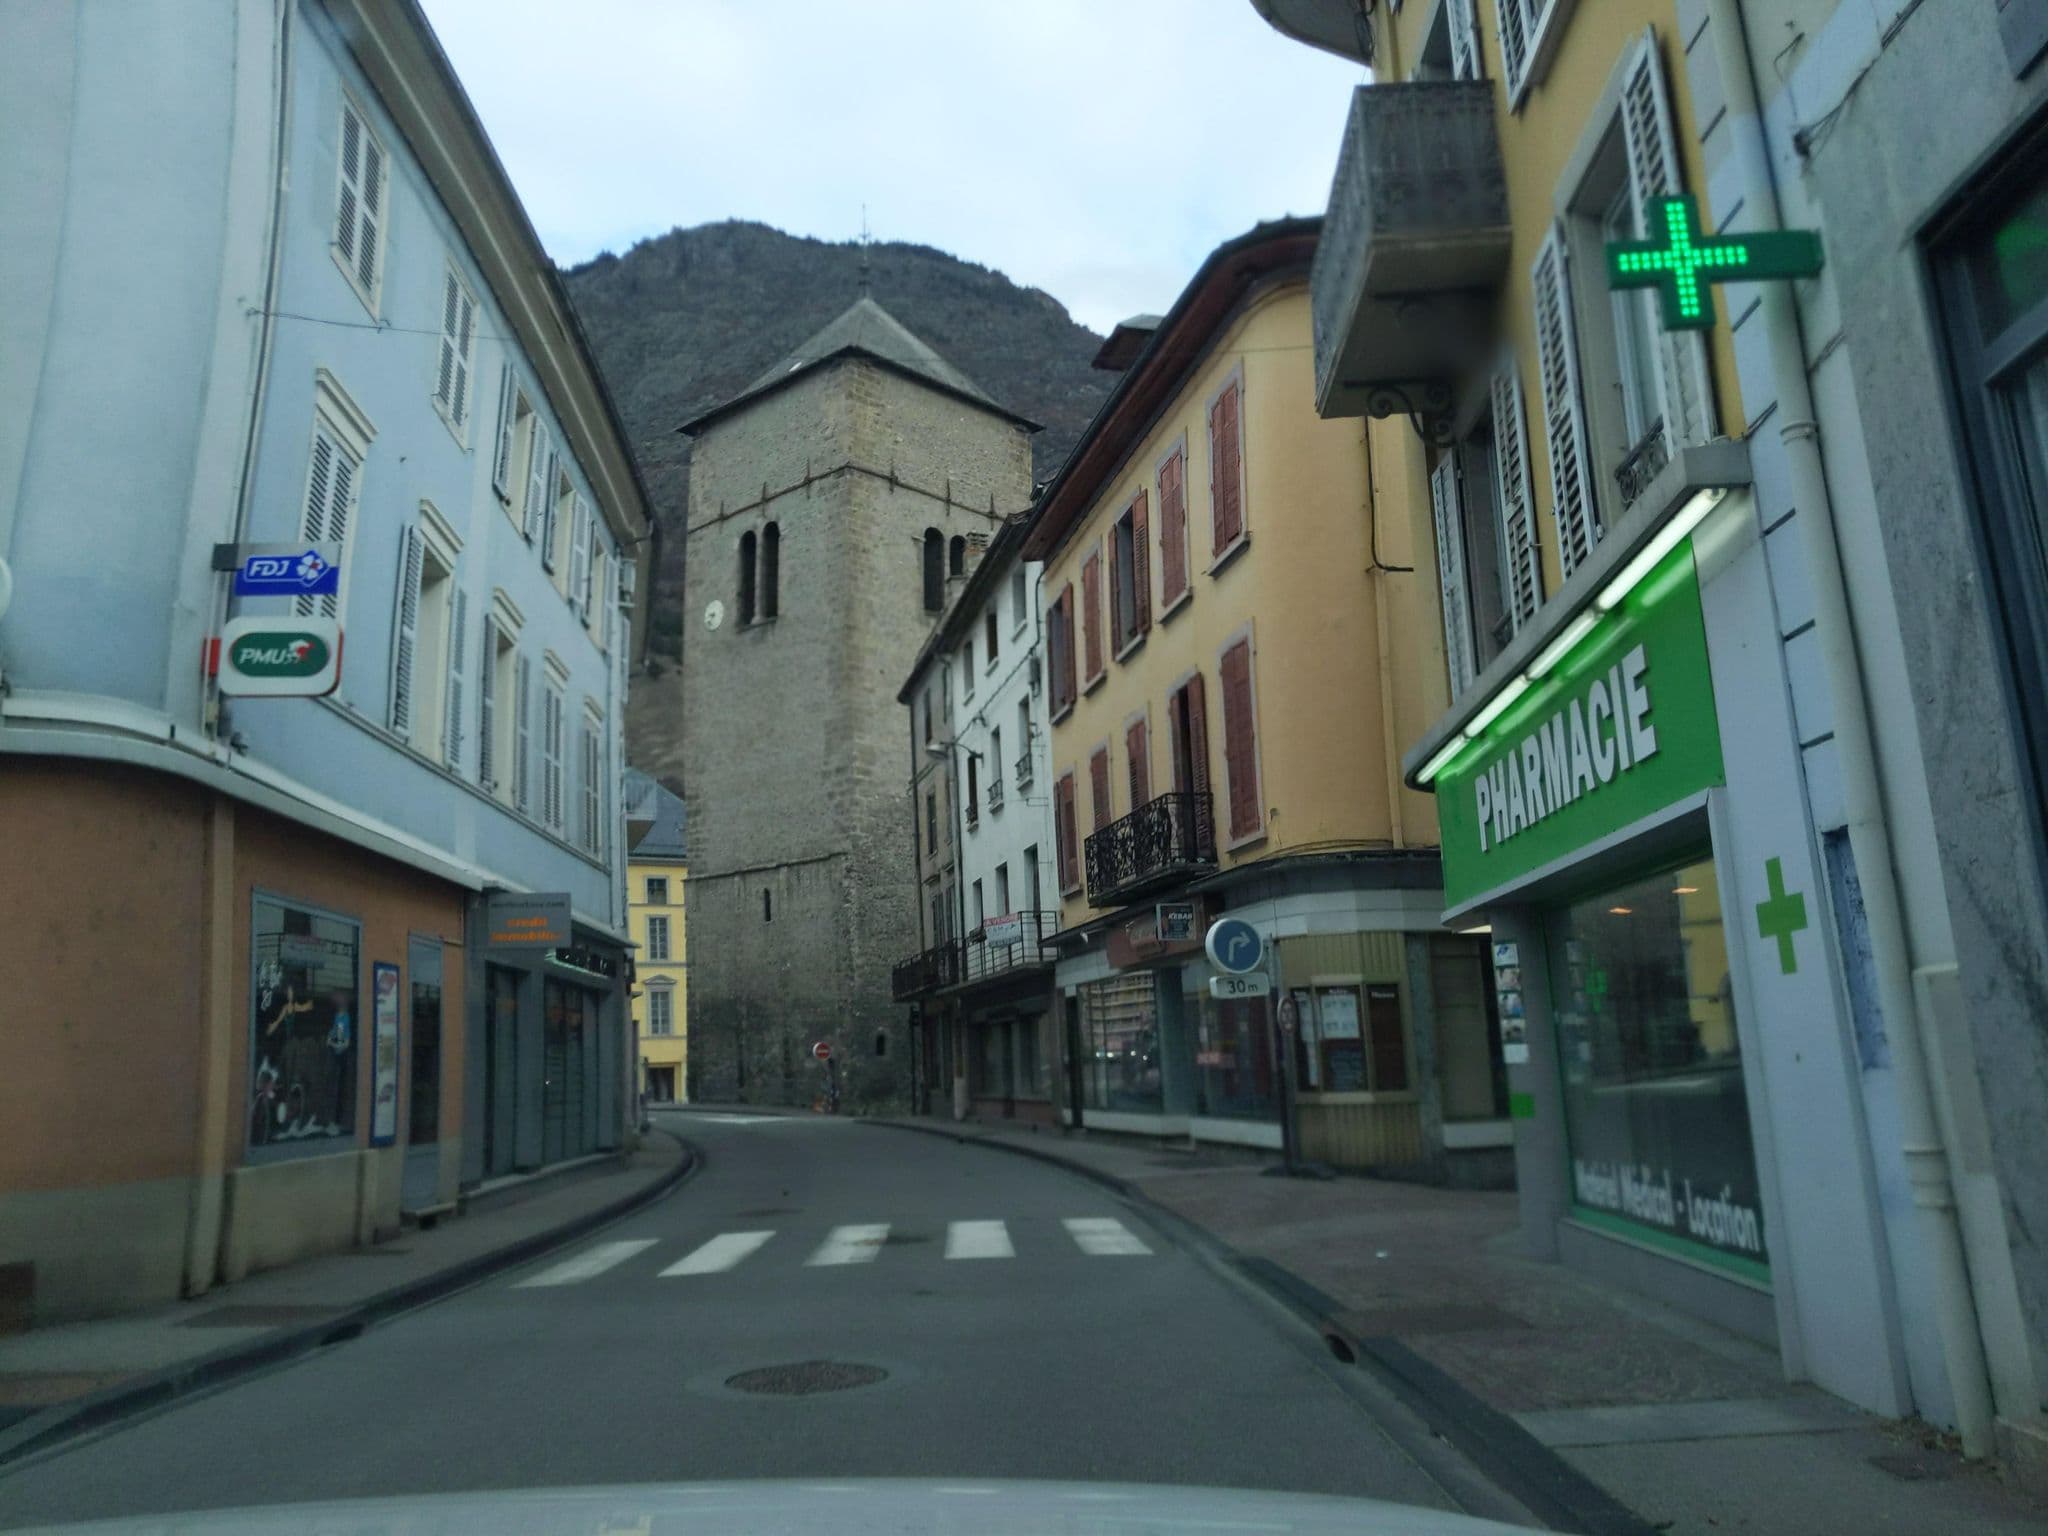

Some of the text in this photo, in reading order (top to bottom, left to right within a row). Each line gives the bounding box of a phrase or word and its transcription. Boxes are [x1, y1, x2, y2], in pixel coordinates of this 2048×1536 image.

[249, 560, 290, 577] FDJ
[240, 647, 285, 665] PMU
[1474, 644, 1657, 852] PHARMACIE
[1227, 980, 1258, 994] 30 m
[1684, 1178, 1760, 1252] Location
